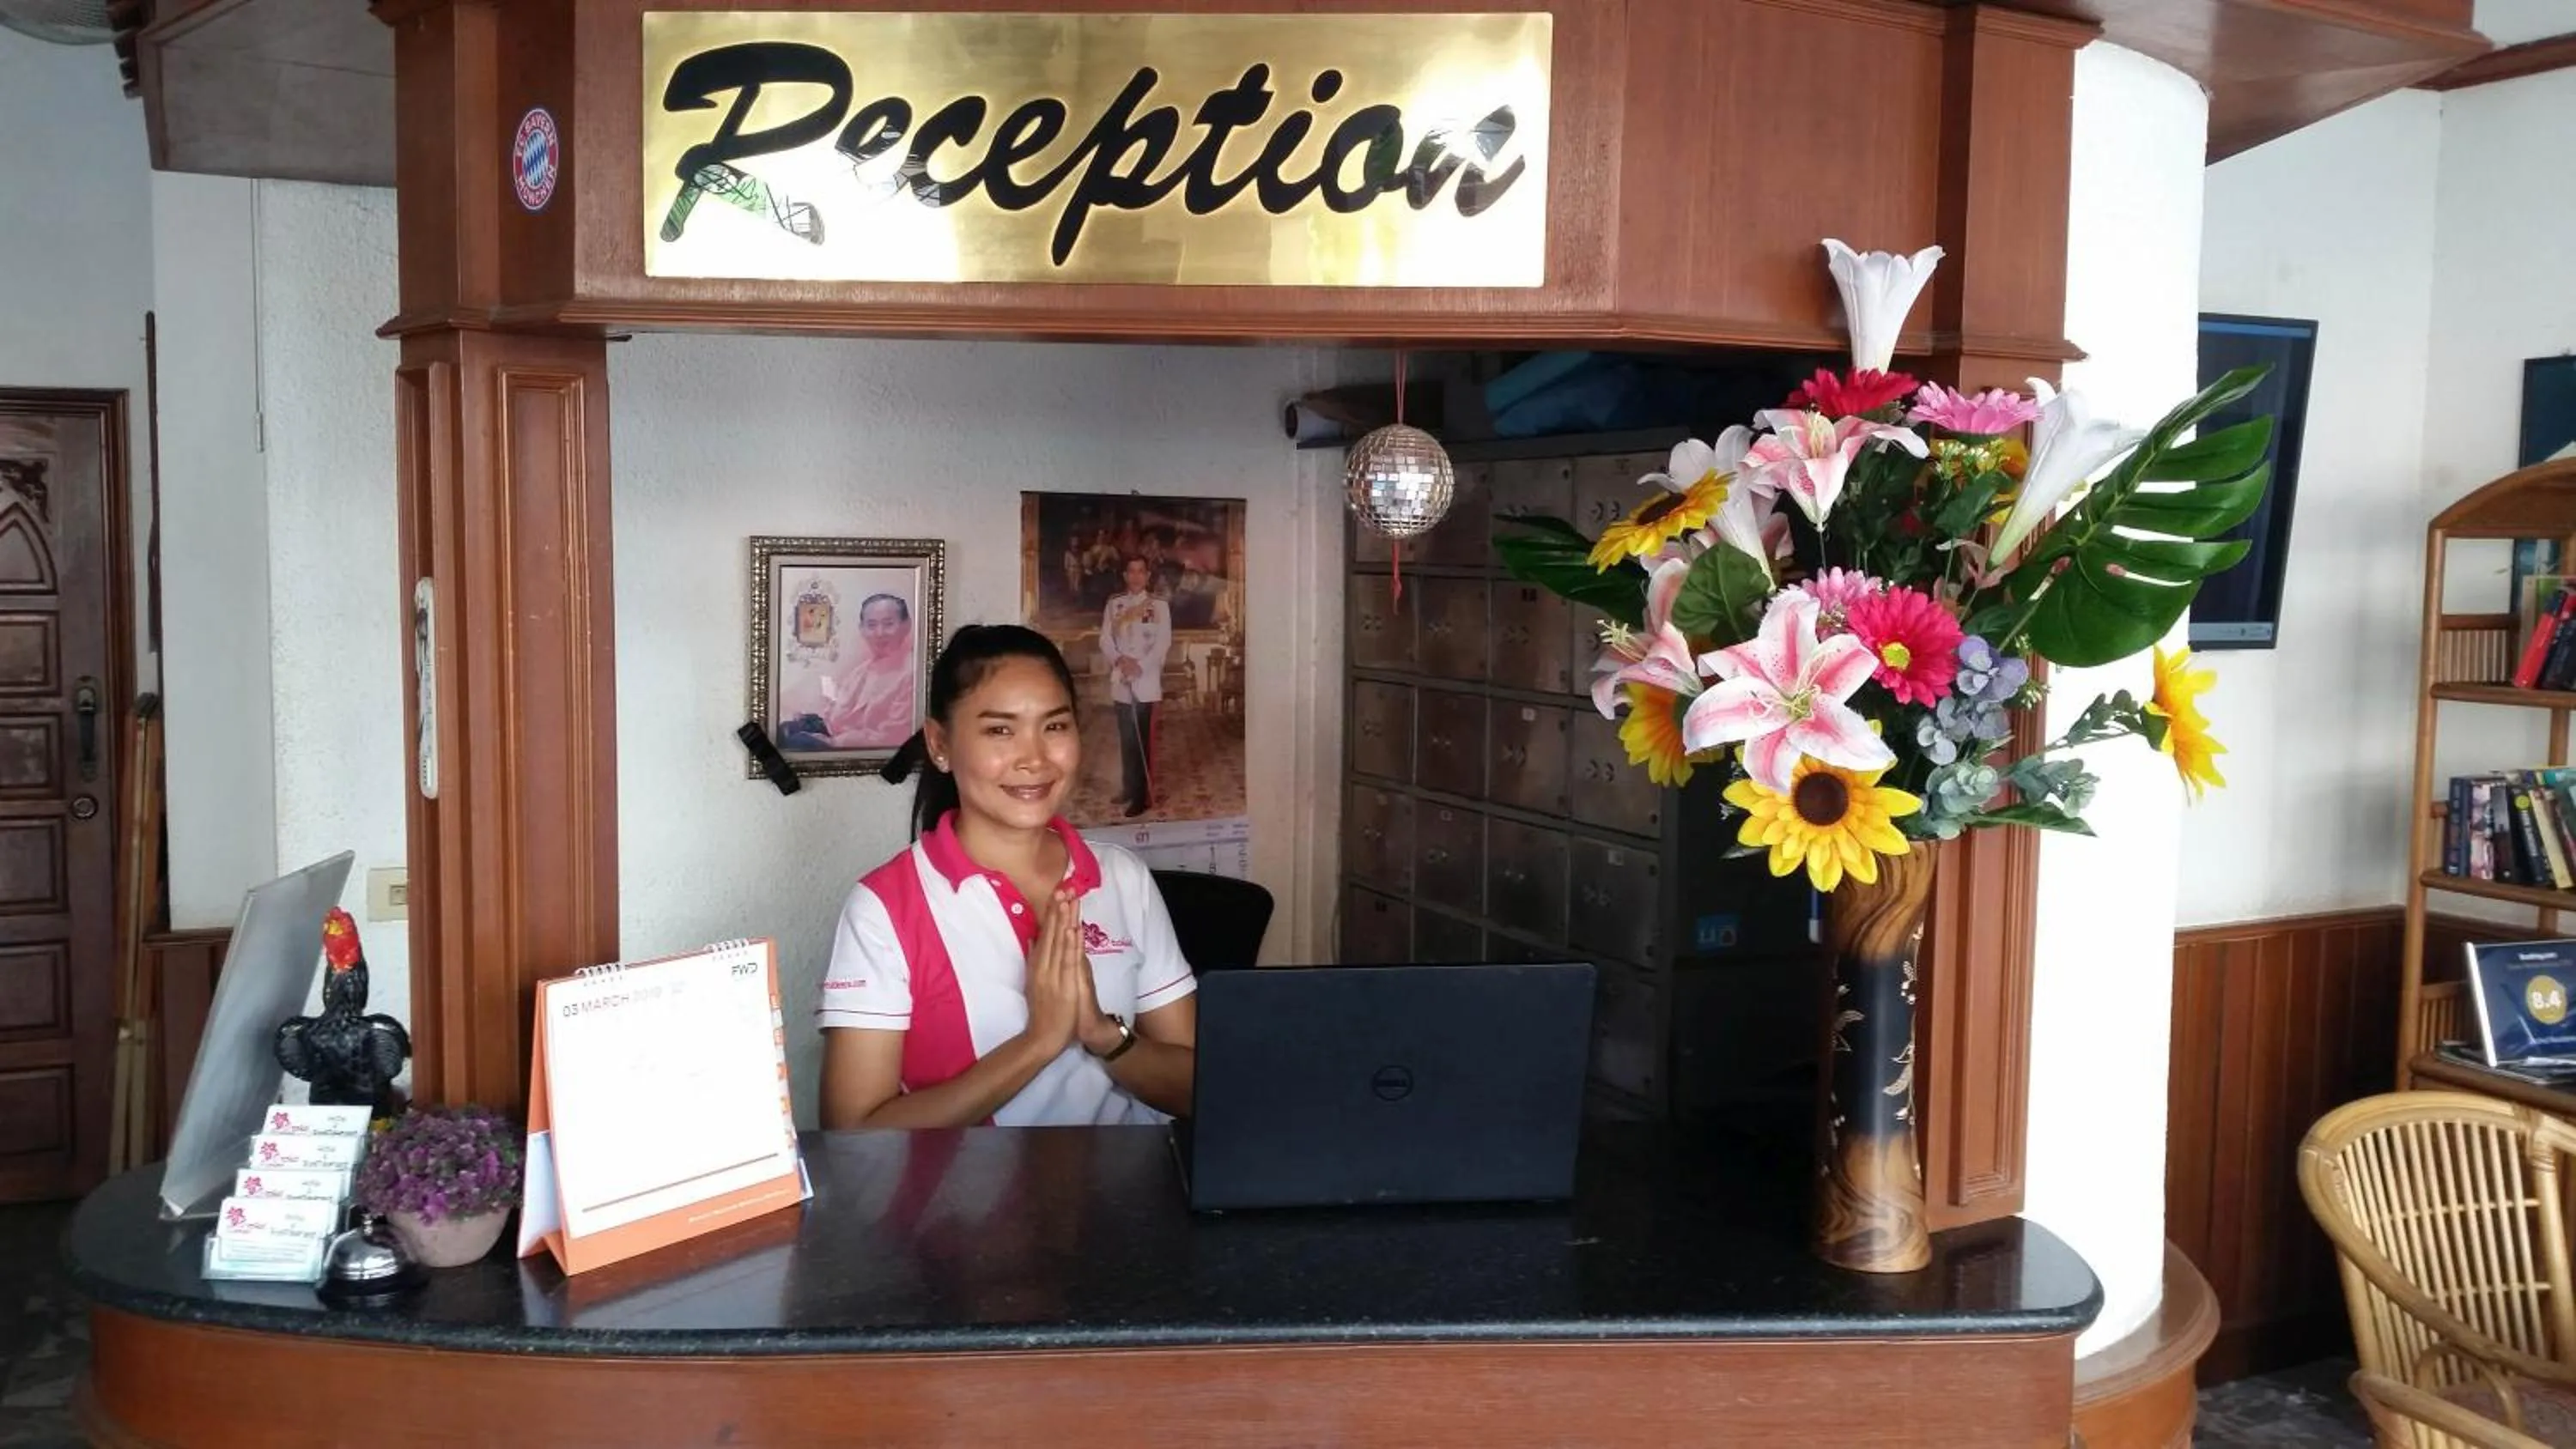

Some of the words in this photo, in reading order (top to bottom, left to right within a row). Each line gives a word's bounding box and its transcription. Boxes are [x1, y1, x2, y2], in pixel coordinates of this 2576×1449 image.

[525, 114, 555, 146] BAYERN
[659, 40, 1525, 266] Reception
[731, 962, 758, 976] FWD
[562, 1003, 580, 1018] 03
[580, 996, 630, 1013] MARCH
[2531, 990, 2562, 1009] 8.4
